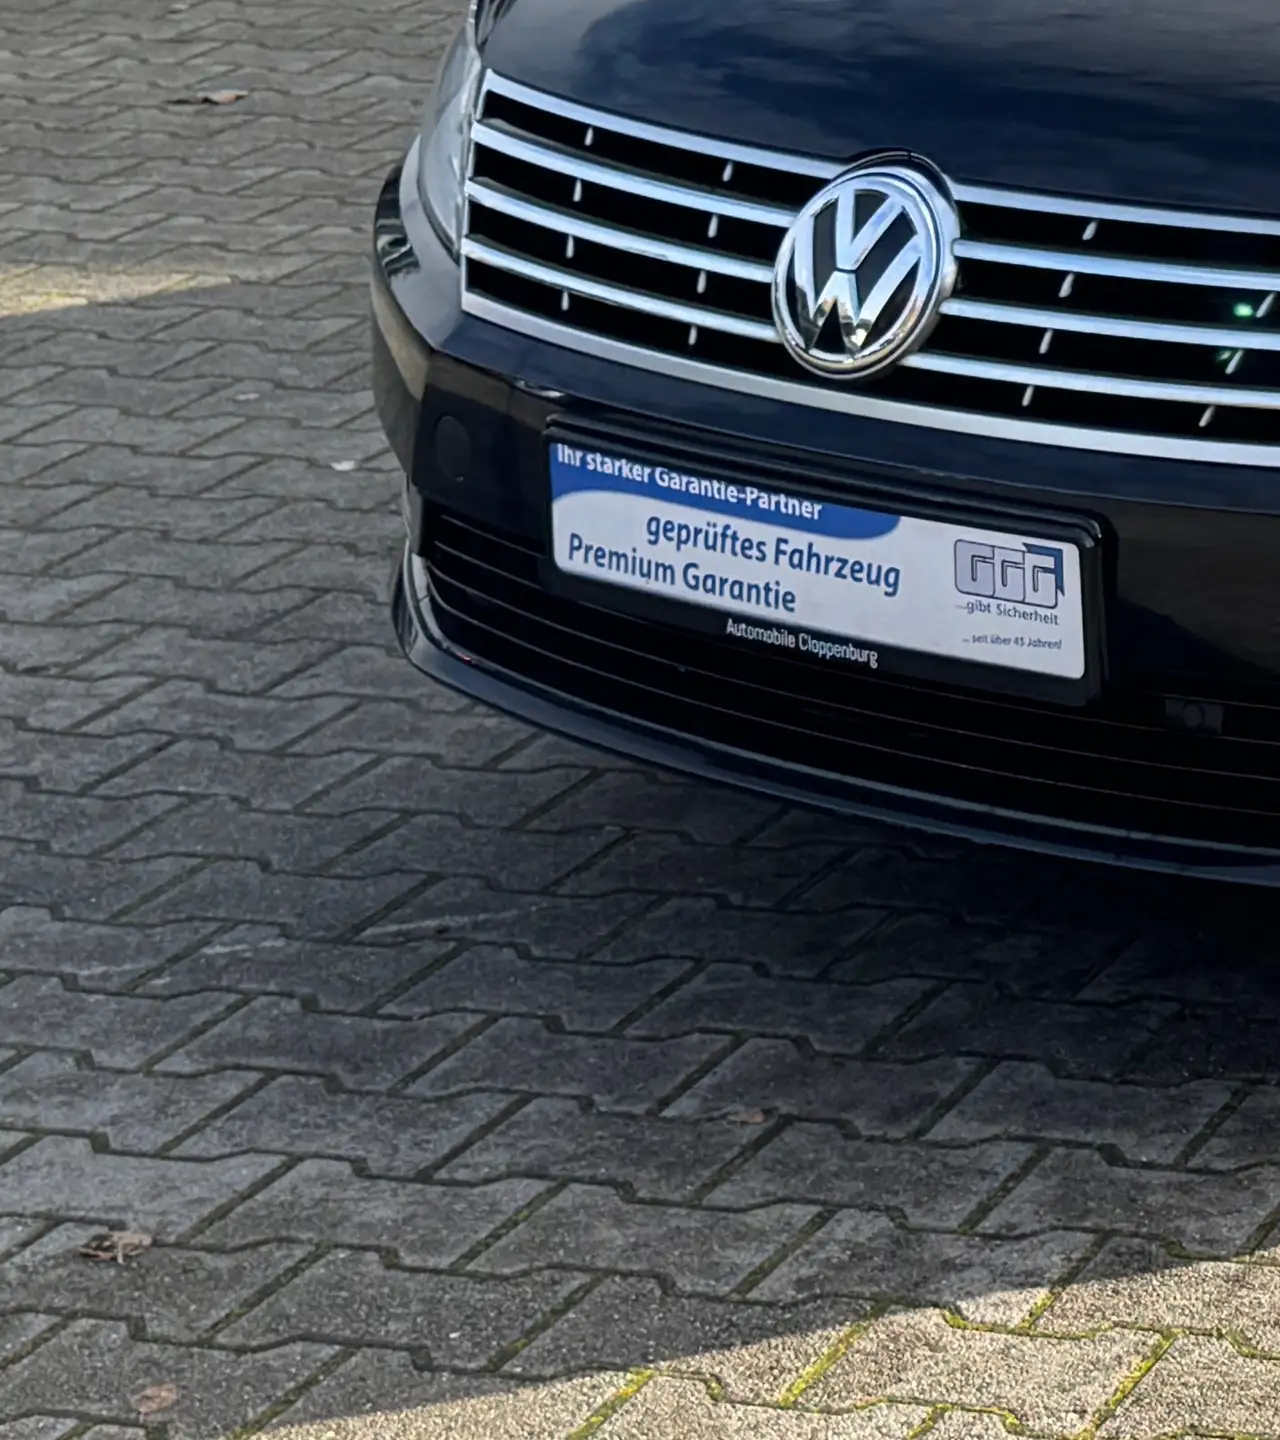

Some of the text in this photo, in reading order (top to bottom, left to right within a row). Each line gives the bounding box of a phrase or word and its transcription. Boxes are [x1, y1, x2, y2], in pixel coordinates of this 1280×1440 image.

[556, 442, 823, 521] Ihr starker Garantie-Partner
[568, 532, 797, 612] Premium Garantie
[646, 515, 901, 598] geprüftes Fahrzeug
[725, 617, 879, 669] Automobile Cloppenburg
[990, 634, 1012, 646] über
[996, 603, 1060, 626] Sicherheit
